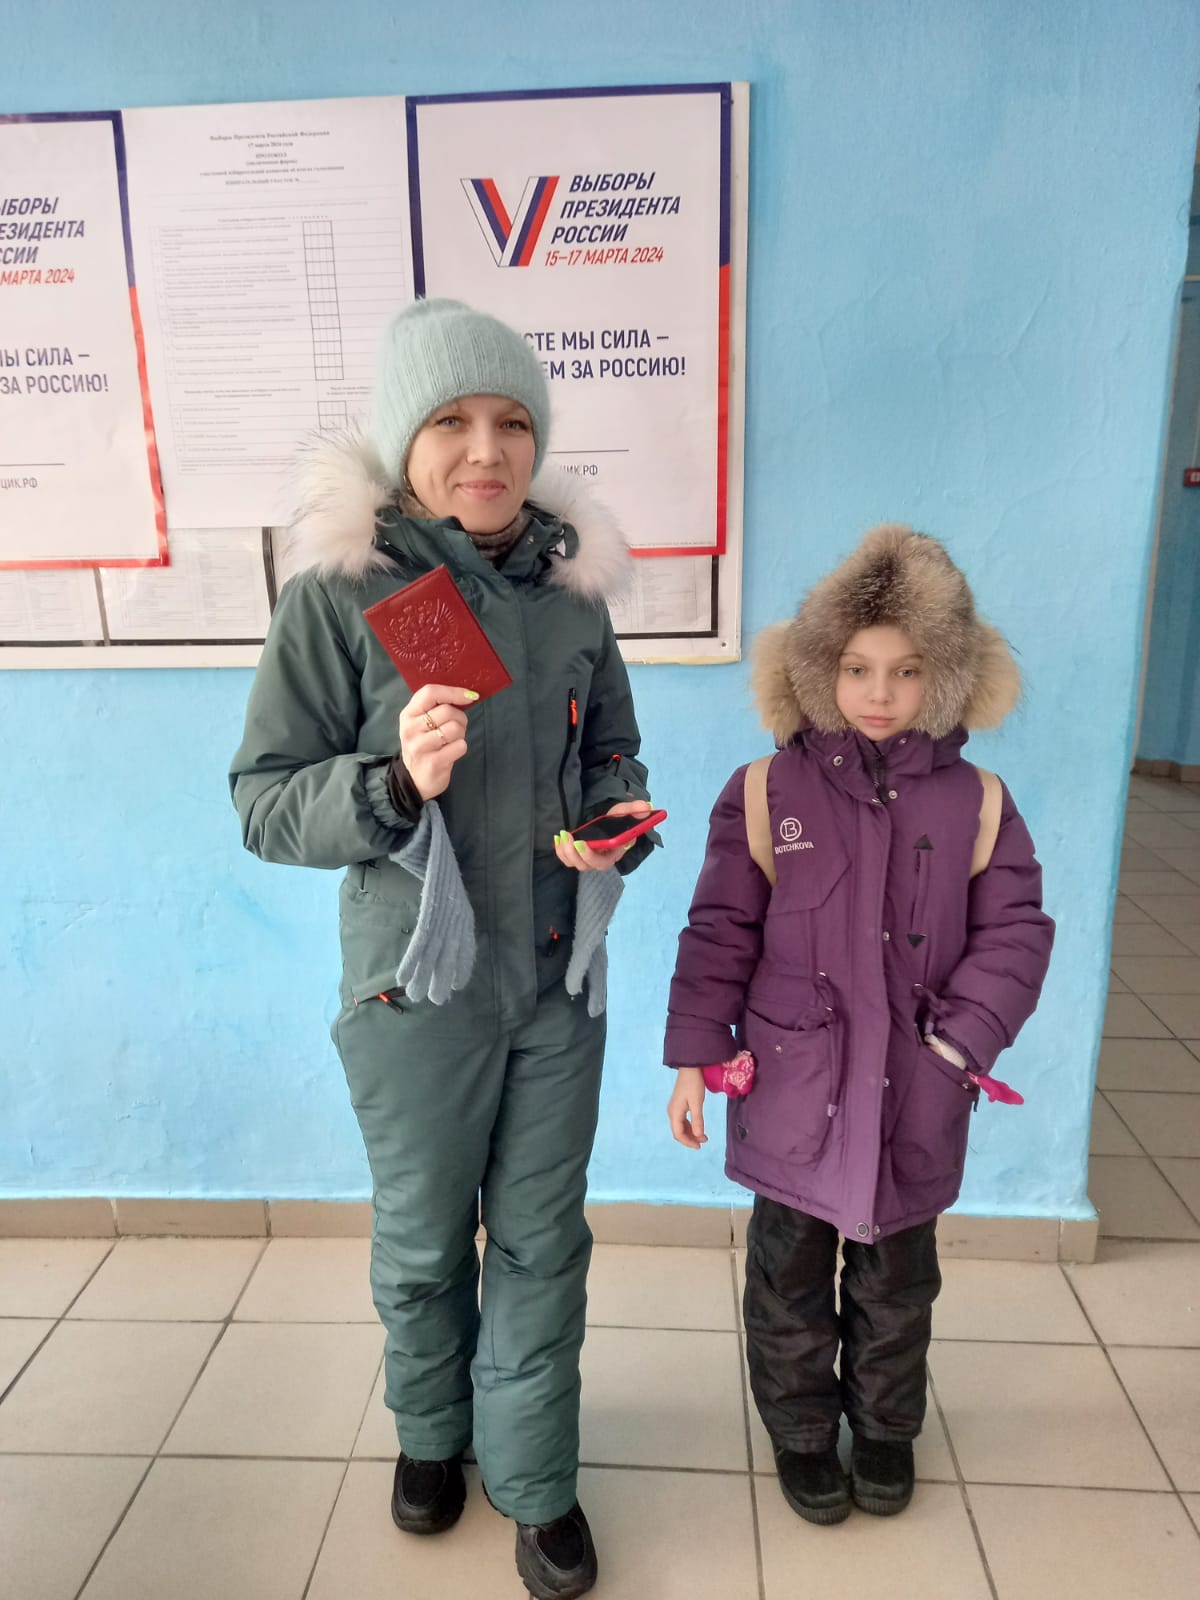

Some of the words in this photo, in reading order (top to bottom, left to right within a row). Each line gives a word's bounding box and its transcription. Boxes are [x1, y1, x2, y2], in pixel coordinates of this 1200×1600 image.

[569, 171, 656, 193] ВЫБОРЫ
[560, 195, 681, 219] ПРЕЗИДЕНТА
[550, 223, 629, 245] РОССИИ
[583, 248, 630, 265] МАРТА
[630, 246, 665, 263] 2024
[0, 269, 42, 286] МАРТА
[44, 267, 76, 284] 2024
[561, 330, 595, 351] МЫ
[600, 328, 652, 349] СИЛА
[0, 348, 21, 368] Ы
[25, 346, 74, 367] СИЛА
[571, 359, 594, 379] ЗА
[599, 356, 687, 379] РОССИЮ!
[0, 375, 22, 395] ЗА
[25, 373, 109, 395] РОССИЮ!
[560, 464, 598, 476] ИК.РФ
[774, 841, 814, 854] BOTCHKOVA
